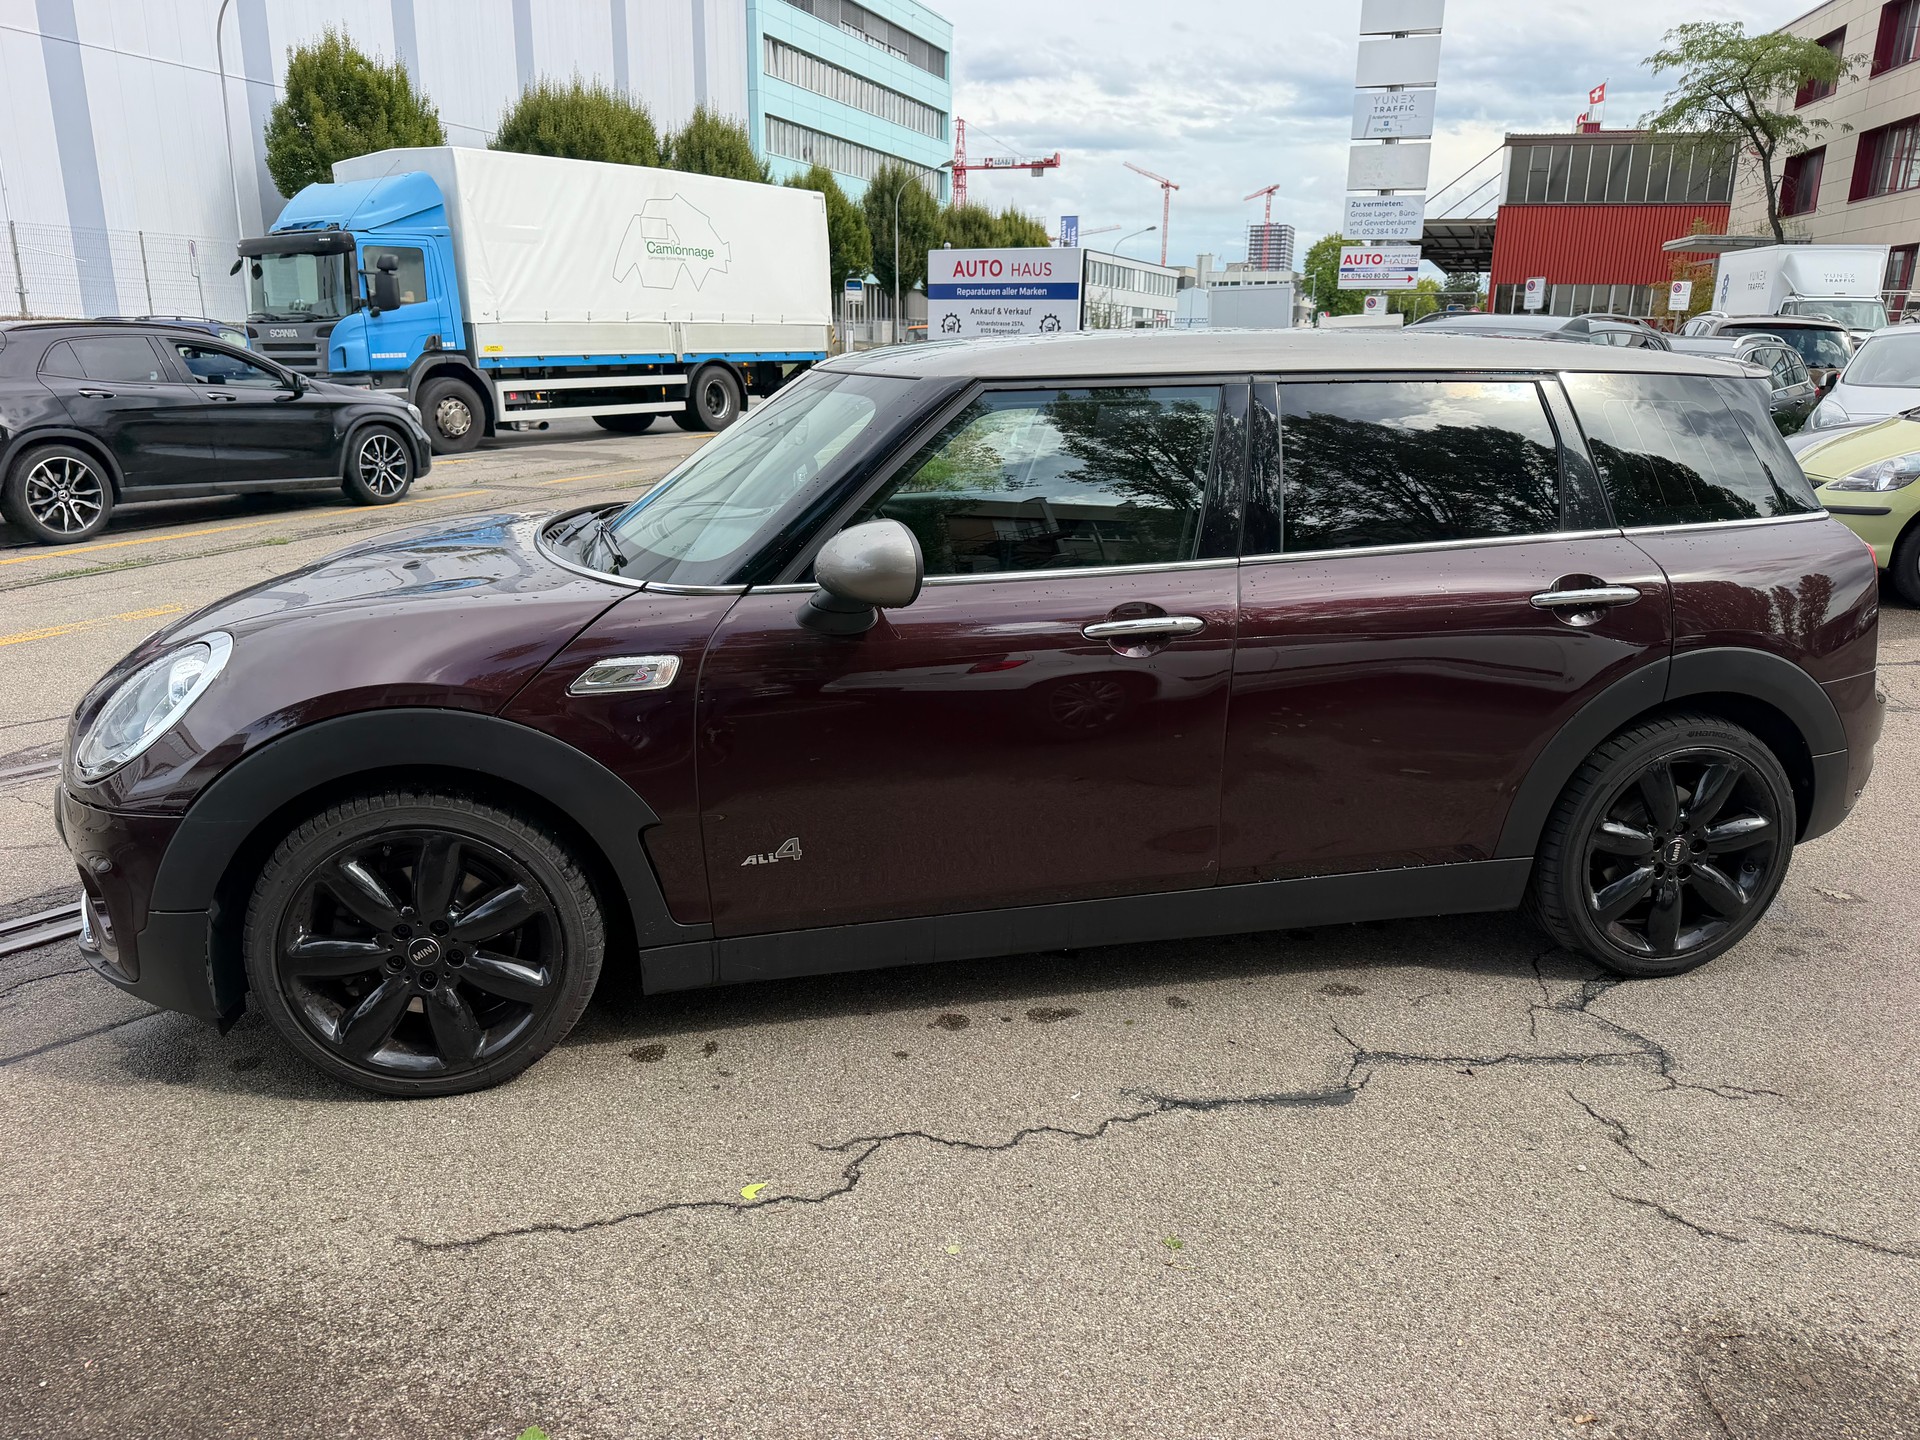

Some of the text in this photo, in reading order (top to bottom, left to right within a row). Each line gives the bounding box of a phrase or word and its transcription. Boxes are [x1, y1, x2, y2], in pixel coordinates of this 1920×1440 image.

[1374, 94, 1416, 105] YUNEX
[1374, 104, 1415, 113] TRAFFIC
[1399, 209, 1418, 217] Büro-
[1364, 219, 1417, 227] Gewerberäume
[646, 240, 714, 260] Camionnage
[1343, 253, 1383, 266] AUTO
[953, 259, 1053, 278] AUTO HAUS
[956, 287, 1048, 297] Reparaturen aller Marken
[970, 307, 1032, 315] Ankauf & Verkauf
[269, 328, 298, 338] SCANIA
[1671, 843, 1682, 861] MINI
[412, 944, 436, 961] MINI
